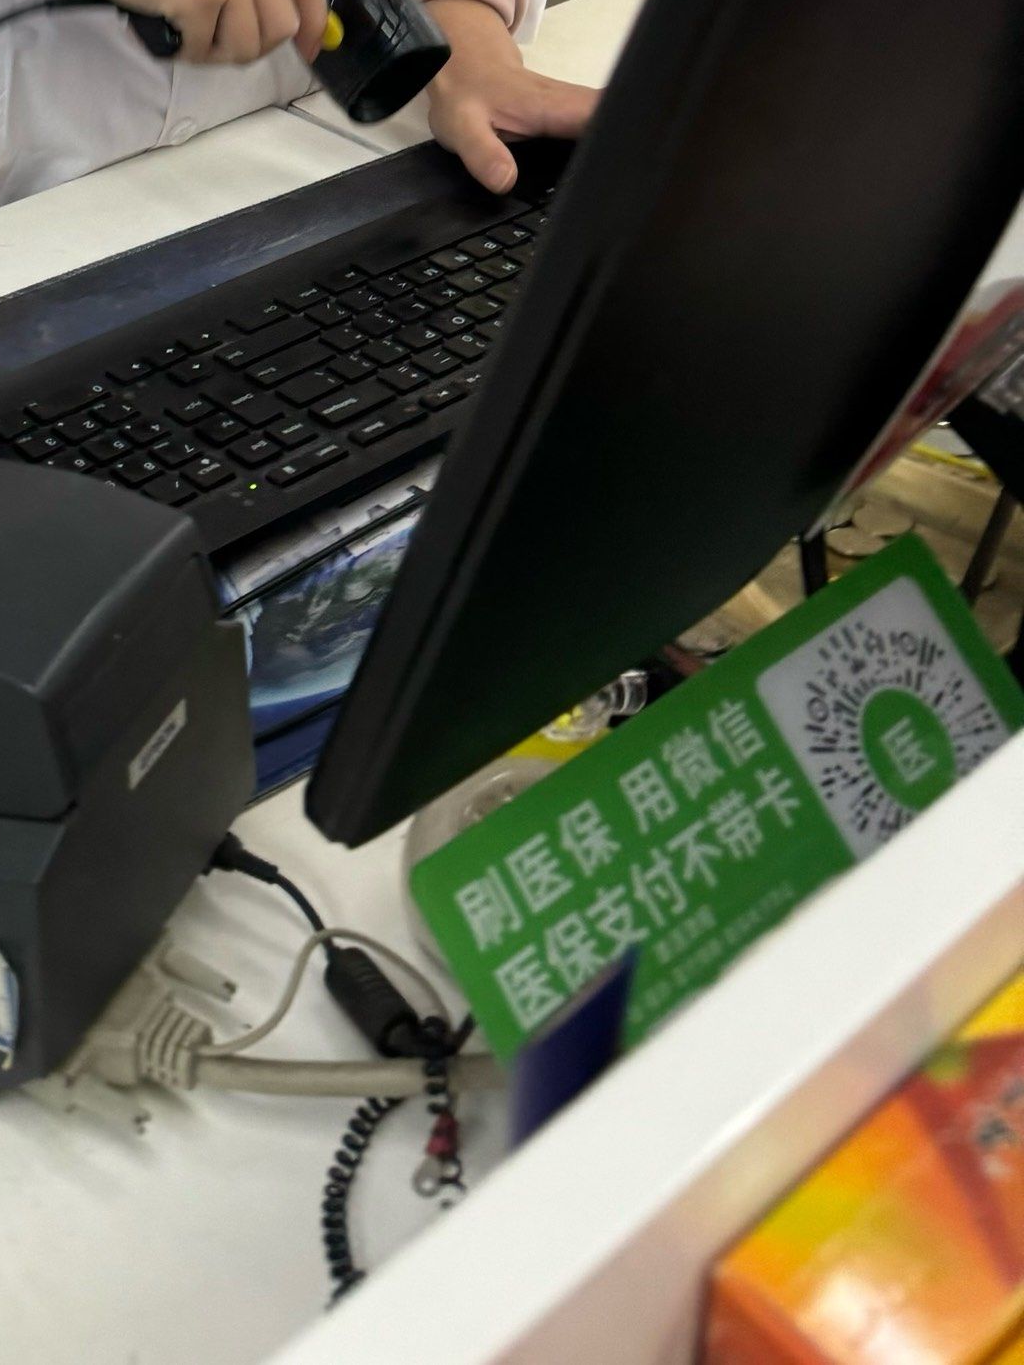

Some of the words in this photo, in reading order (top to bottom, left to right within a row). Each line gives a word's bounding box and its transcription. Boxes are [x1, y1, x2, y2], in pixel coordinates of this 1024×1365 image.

[454, 799, 621, 951] 刷医保
[619, 698, 766, 835] 用微信
[881, 716, 940, 784] 医
[494, 767, 801, 1030] 医保支付不带卡
